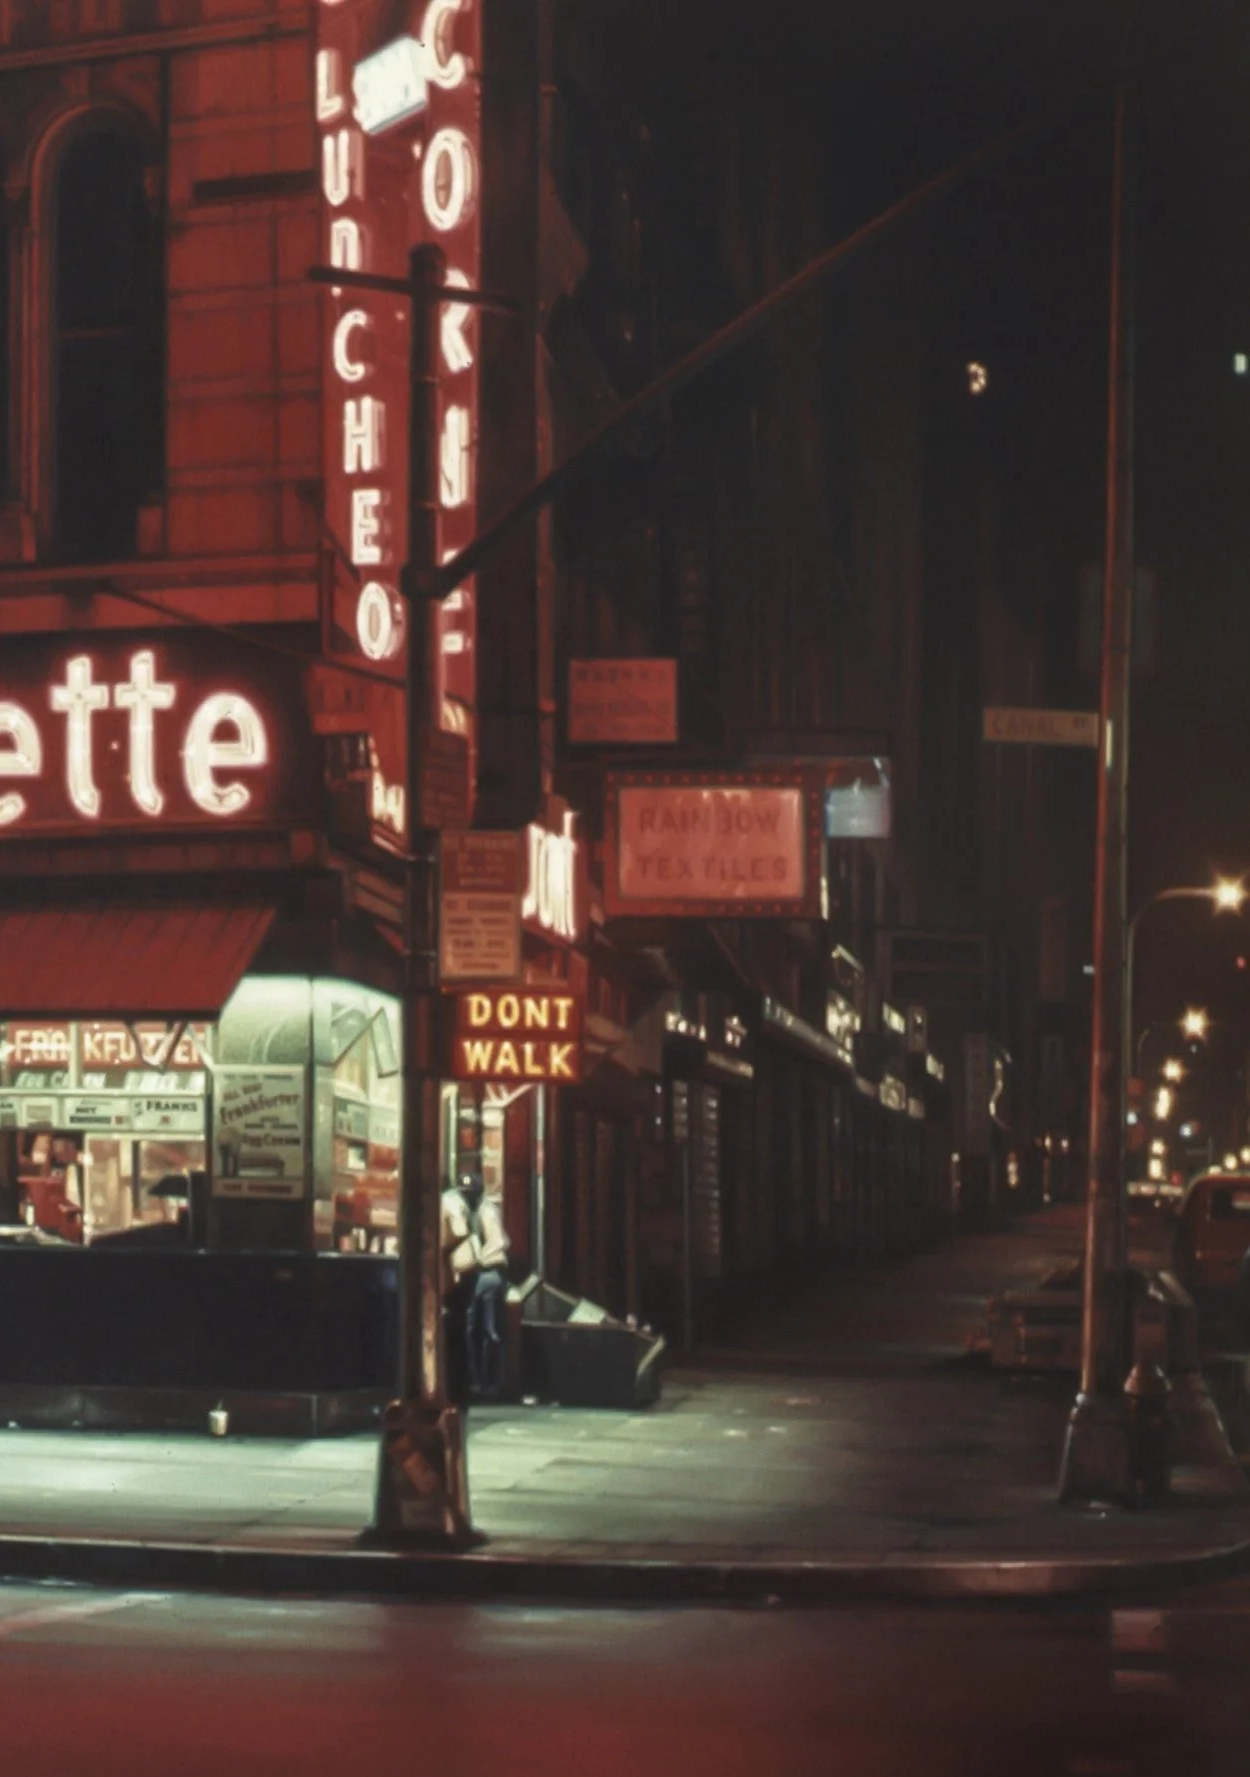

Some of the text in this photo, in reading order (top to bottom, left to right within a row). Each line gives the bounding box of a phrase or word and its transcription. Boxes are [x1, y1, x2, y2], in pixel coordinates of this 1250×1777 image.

[638, 808, 781, 835] RAINBOW
[637, 856, 788, 881] TEXTILES
[467, 993, 574, 1029] DONT
[463, 1040, 576, 1076] WALK
[145, 1100, 198, 1113] FRANKS
